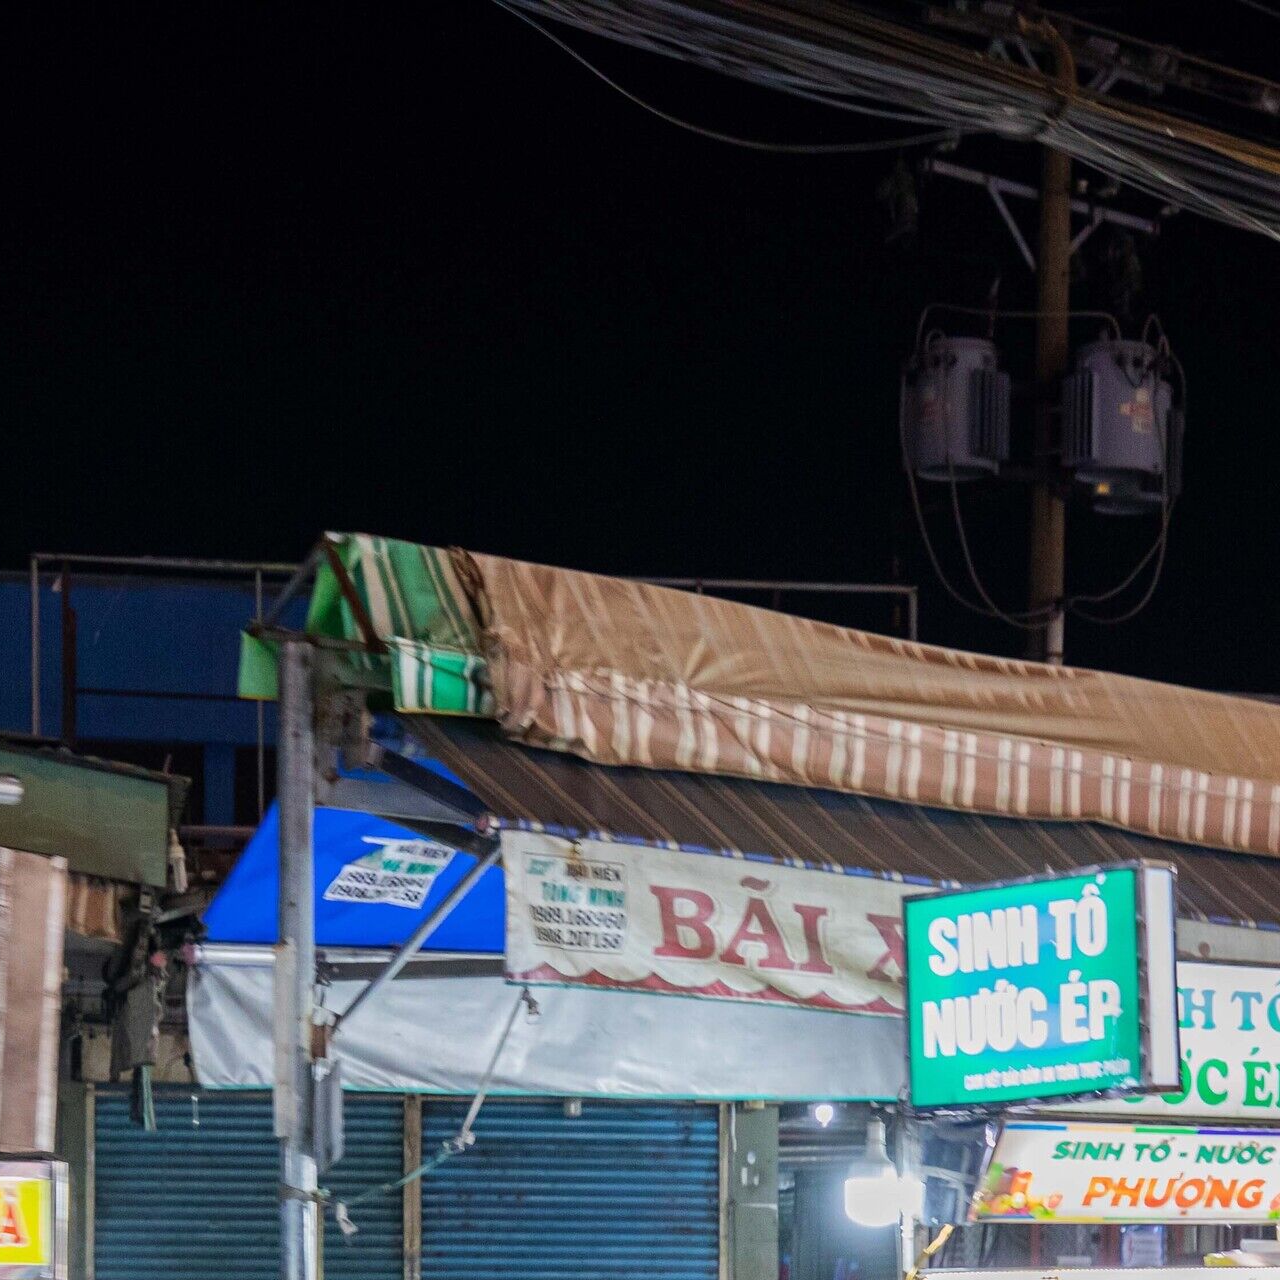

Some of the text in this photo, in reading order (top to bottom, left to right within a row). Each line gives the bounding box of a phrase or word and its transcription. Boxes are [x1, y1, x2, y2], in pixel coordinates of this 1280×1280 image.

[650, 876, 833, 975] BÃI
[928, 873, 1109, 977] SINH TỐ
[923, 970, 1121, 1060] NƯỚC ÉP
[1052, 1140, 1126, 1163] SINH
[1134, 1135, 1177, 1164] TỐ
[1195, 1141, 1277, 1166] NƯỚC
[1082, 1174, 1266, 1215] PHƯỢNG
